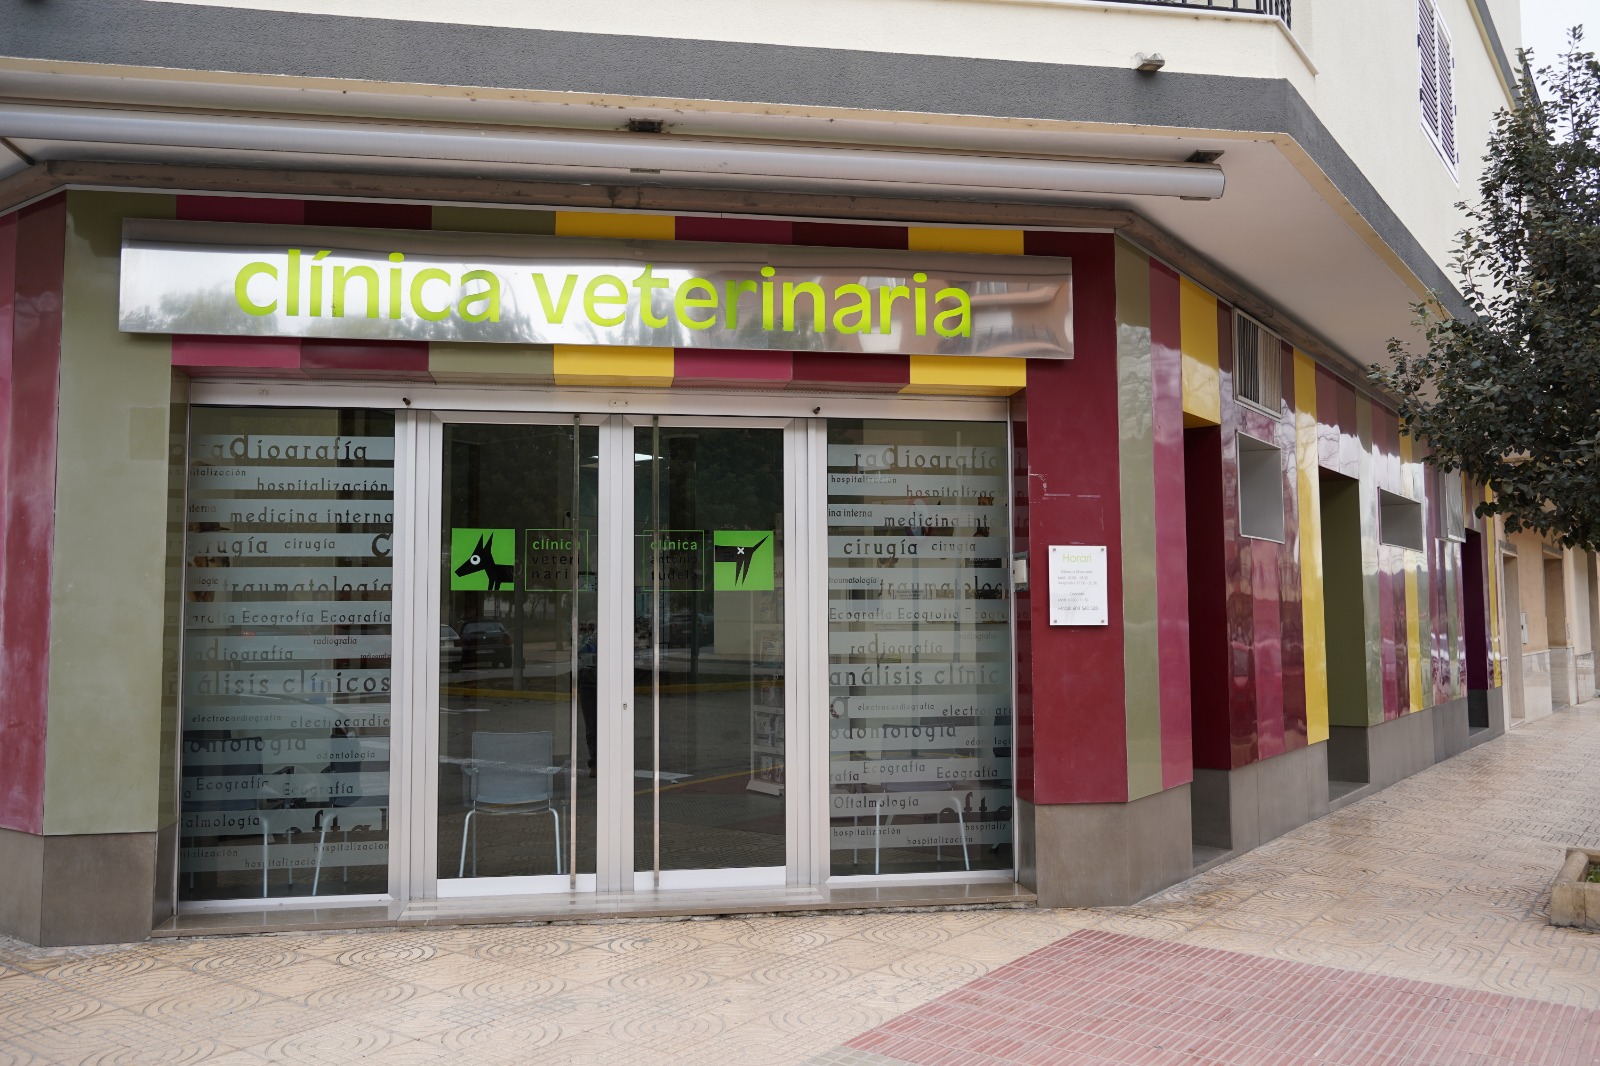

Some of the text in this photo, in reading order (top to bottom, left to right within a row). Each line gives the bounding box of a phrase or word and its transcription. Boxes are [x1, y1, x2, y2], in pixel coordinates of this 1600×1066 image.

[235, 249, 972, 338] clínica veterinaria
[257, 477, 389, 491] hospitalización
[230, 507, 393, 523] medicina interna
[883, 511, 960, 528] medicina
[284, 536, 336, 551] cirugía
[532, 538, 580, 550] clínic
[843, 539, 918, 558] cirugía
[931, 541, 977, 554] cirugía
[1062, 553, 1092, 563] Horari
[320, 609, 391, 625] Ecografía
[829, 607, 892, 622] Ecografía
[313, 636, 358, 646] radiografía
[829, 663, 923, 685] análisis
[282, 669, 391, 694] clínicos
[316, 750, 376, 761] odontología
[862, 761, 926, 775] Ecografía
[936, 766, 998, 780] Ecografía
[196, 777, 269, 792] Ecografía
[833, 796, 919, 810] Oftalmología
[833, 827, 901, 837] hospitalización
